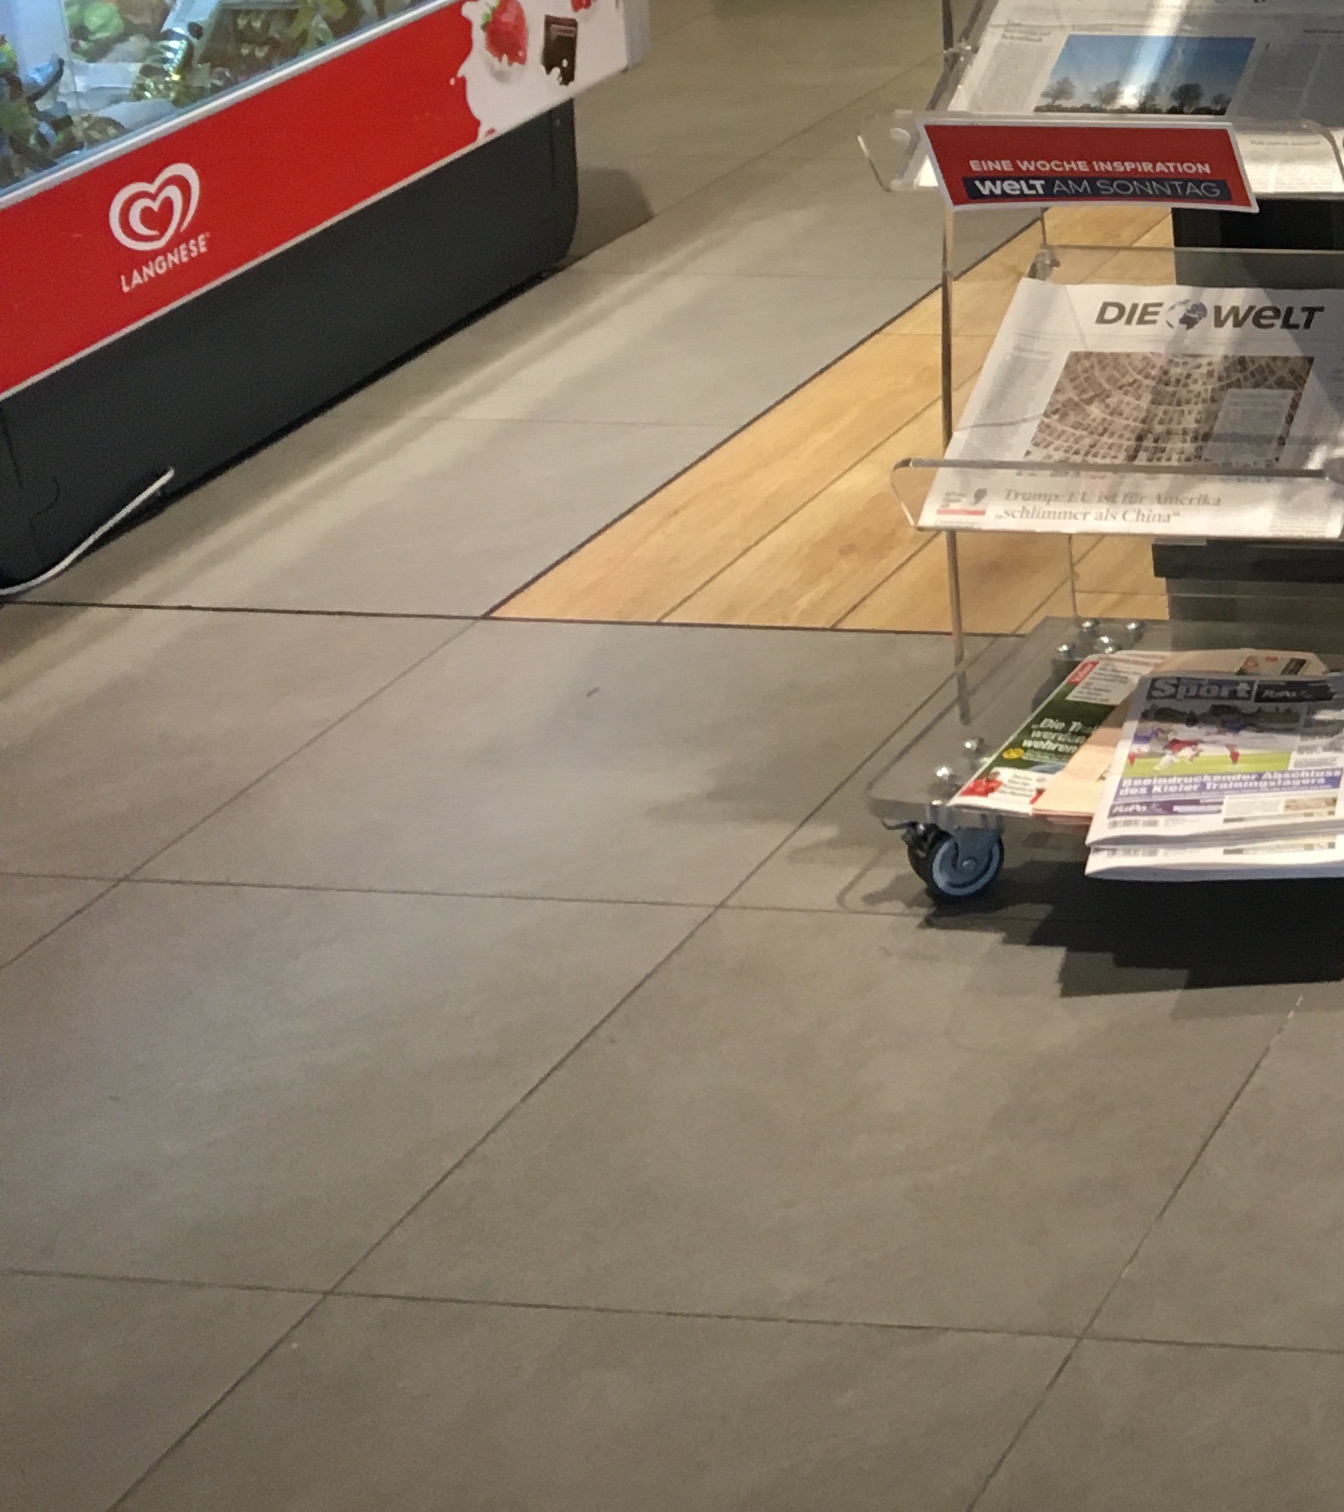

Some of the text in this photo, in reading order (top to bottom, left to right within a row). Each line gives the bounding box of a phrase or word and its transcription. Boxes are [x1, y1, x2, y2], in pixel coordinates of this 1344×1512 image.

[969, 159, 1211, 174] EINE WOCHE INSPIRATION
[1053, 180, 1093, 196] AM
[1097, 180, 1221, 198] SONNTAG
[120, 233, 209, 294] LANGNESE
[1095, 301, 1164, 326] DIE
[1094, 508, 1117, 522] als
[1151, 677, 1251, 699] Sport
